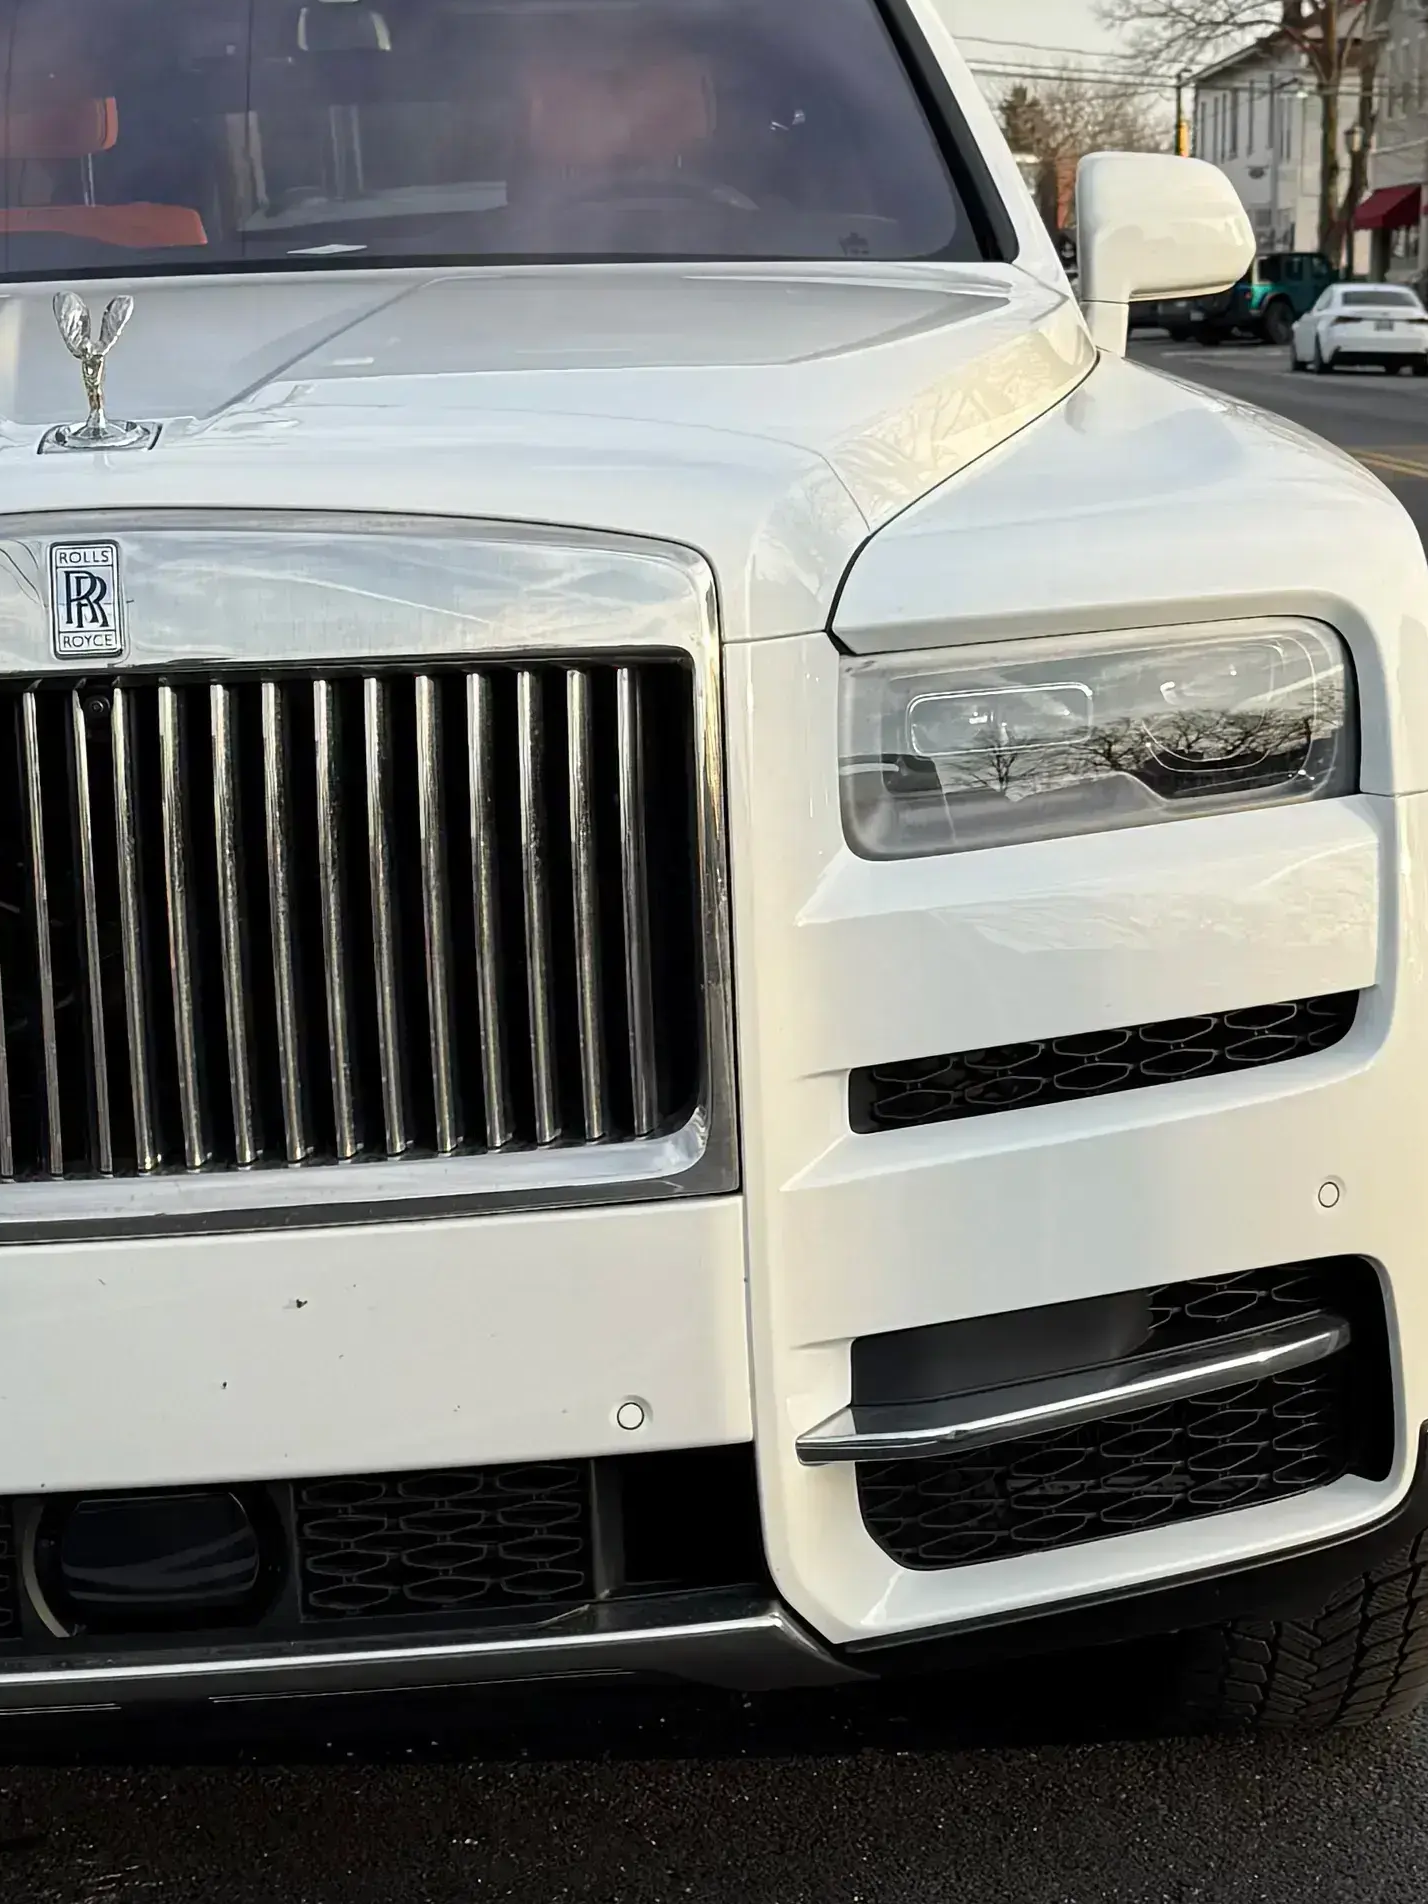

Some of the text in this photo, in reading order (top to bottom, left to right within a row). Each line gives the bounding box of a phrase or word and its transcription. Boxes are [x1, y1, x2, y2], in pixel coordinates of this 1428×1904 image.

[58, 549, 110, 565] ROLLS
[64, 569, 109, 628] RR
[62, 633, 114, 649] ROYCE
